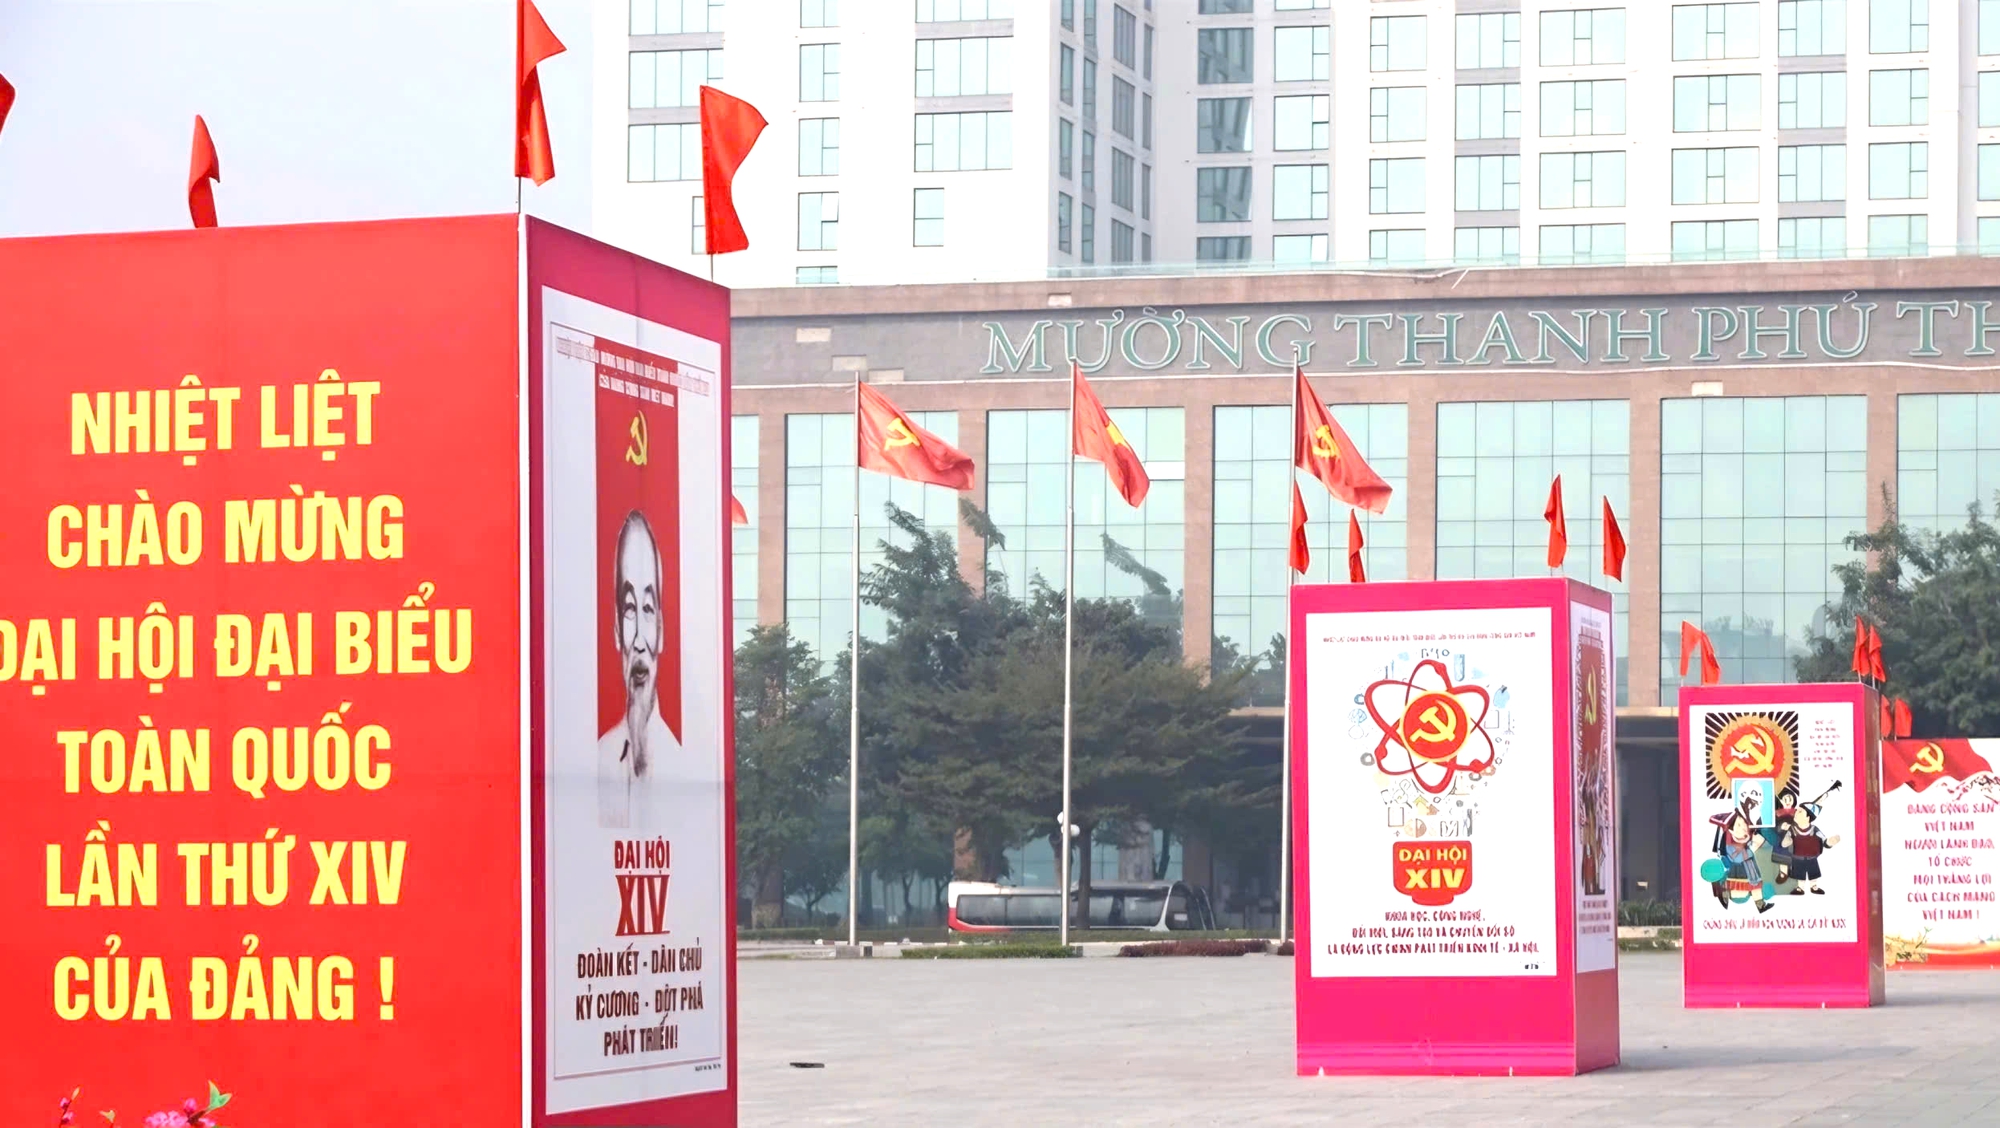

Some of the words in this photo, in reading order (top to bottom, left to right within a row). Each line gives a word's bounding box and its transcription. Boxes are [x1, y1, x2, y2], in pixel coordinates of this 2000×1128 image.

[980, 307, 1315, 373] MƯỜNG
[1334, 308, 1670, 366] THANH
[1690, 290, 1877, 361] PHÚ
[71, 374, 240, 466] NHIỆT
[260, 368, 381, 461] LIỆT
[47, 489, 203, 568] CHÀO
[224, 484, 404, 563] MỪNG
[98, 601, 194, 693] HỘI
[213, 613, 312, 691] ĐẠI
[335, 581, 472, 675] BIỂU
[57, 715, 210, 793] TOÀN
[232, 702, 391, 799] QUỐC
[45, 821, 157, 906] LẦN
[178, 828, 296, 906] THỨ
[309, 841, 407, 905] XIV
[614, 841, 640, 874] ĐẠI
[645, 835, 670, 874] HỘI
[1399, 848, 1430, 865] ĐẠI
[1437, 845, 1467, 865] HỘI
[1405, 868, 1465, 889] XIV
[615, 875, 670, 936] XIV
[53, 934, 171, 1021] CỦA
[189, 934, 354, 1021] ĐẢNG
[379, 957, 394, 1021] !
[577, 947, 613, 978] ĐOÀN
[652, 944, 676, 974] DÂN
[597, 989, 639, 1018] CƯƠNG
[680, 981, 703, 1011] PHÁ
[604, 1024, 636, 1056] PHÁT
